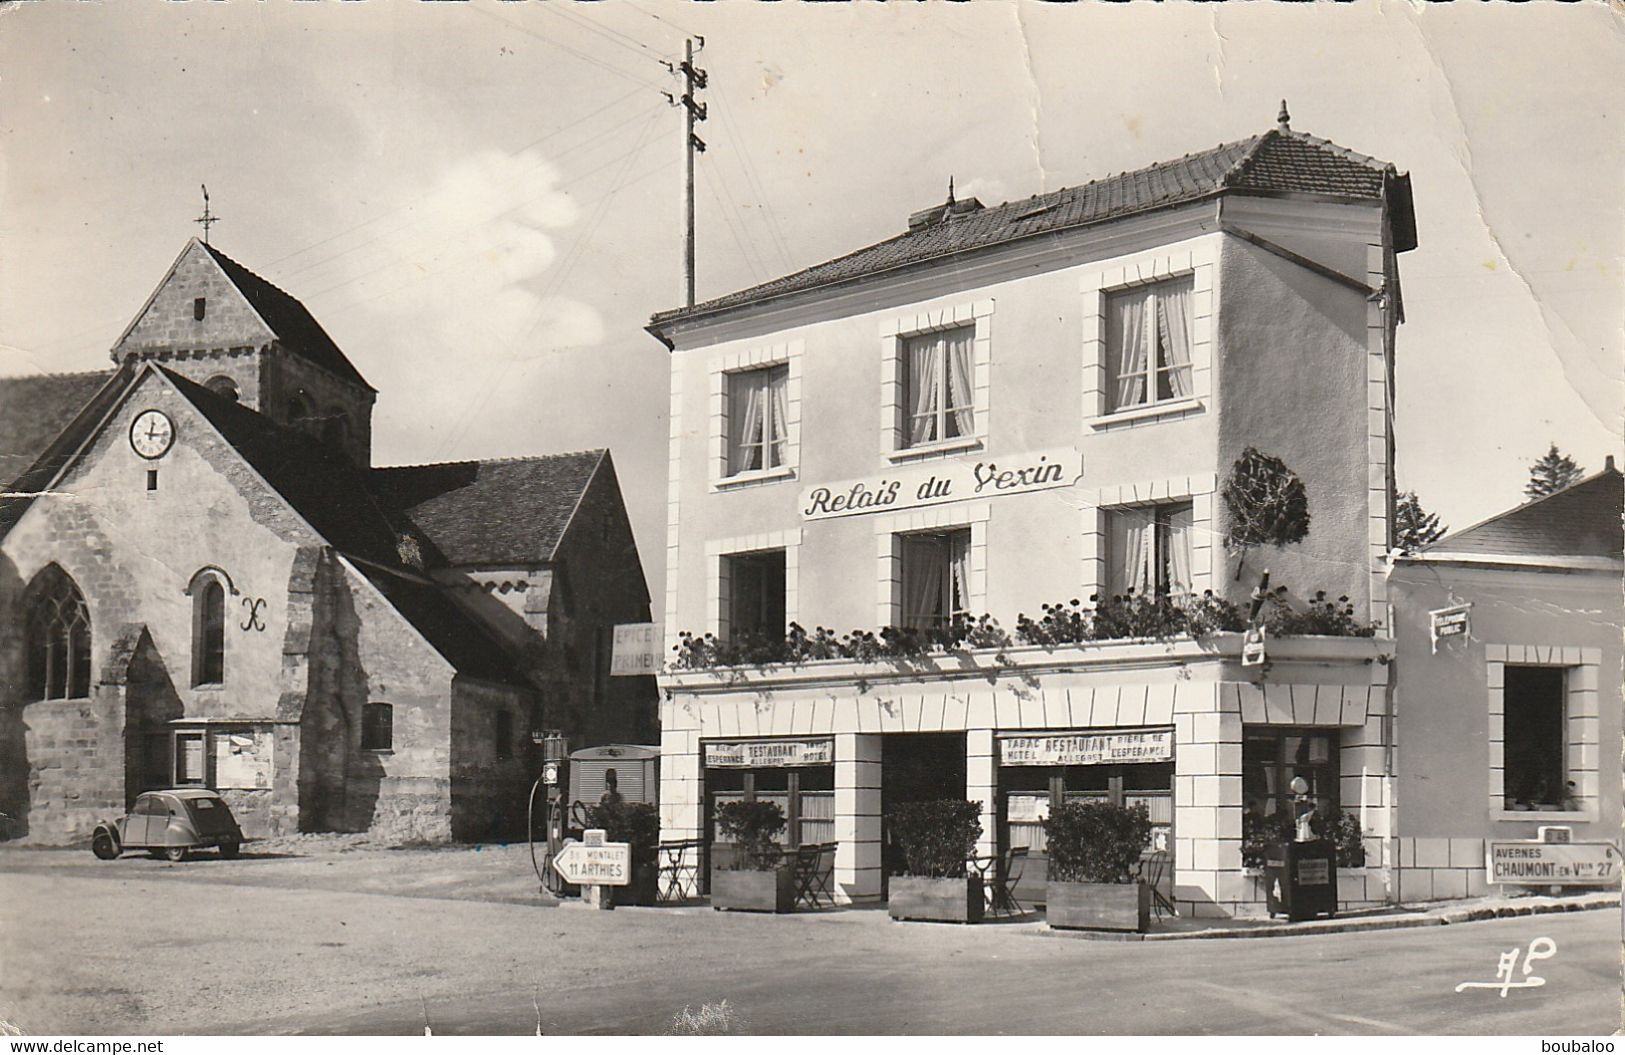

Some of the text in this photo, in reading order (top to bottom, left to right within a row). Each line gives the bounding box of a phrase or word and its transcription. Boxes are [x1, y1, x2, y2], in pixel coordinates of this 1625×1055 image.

[804, 455, 1063, 516] Relais du Vexin
[1007, 737, 1113, 753] TABAC RESTAURANT
[803, 751, 827, 761] HOTEL
[1007, 750, 1037, 760] HOTEL
[586, 850, 625, 861] MONTALET
[1496, 848, 1613, 859] AVERNES 6
[569, 863, 623, 877] 11 ARTHIES
[1597, 862, 1613, 876] 27
